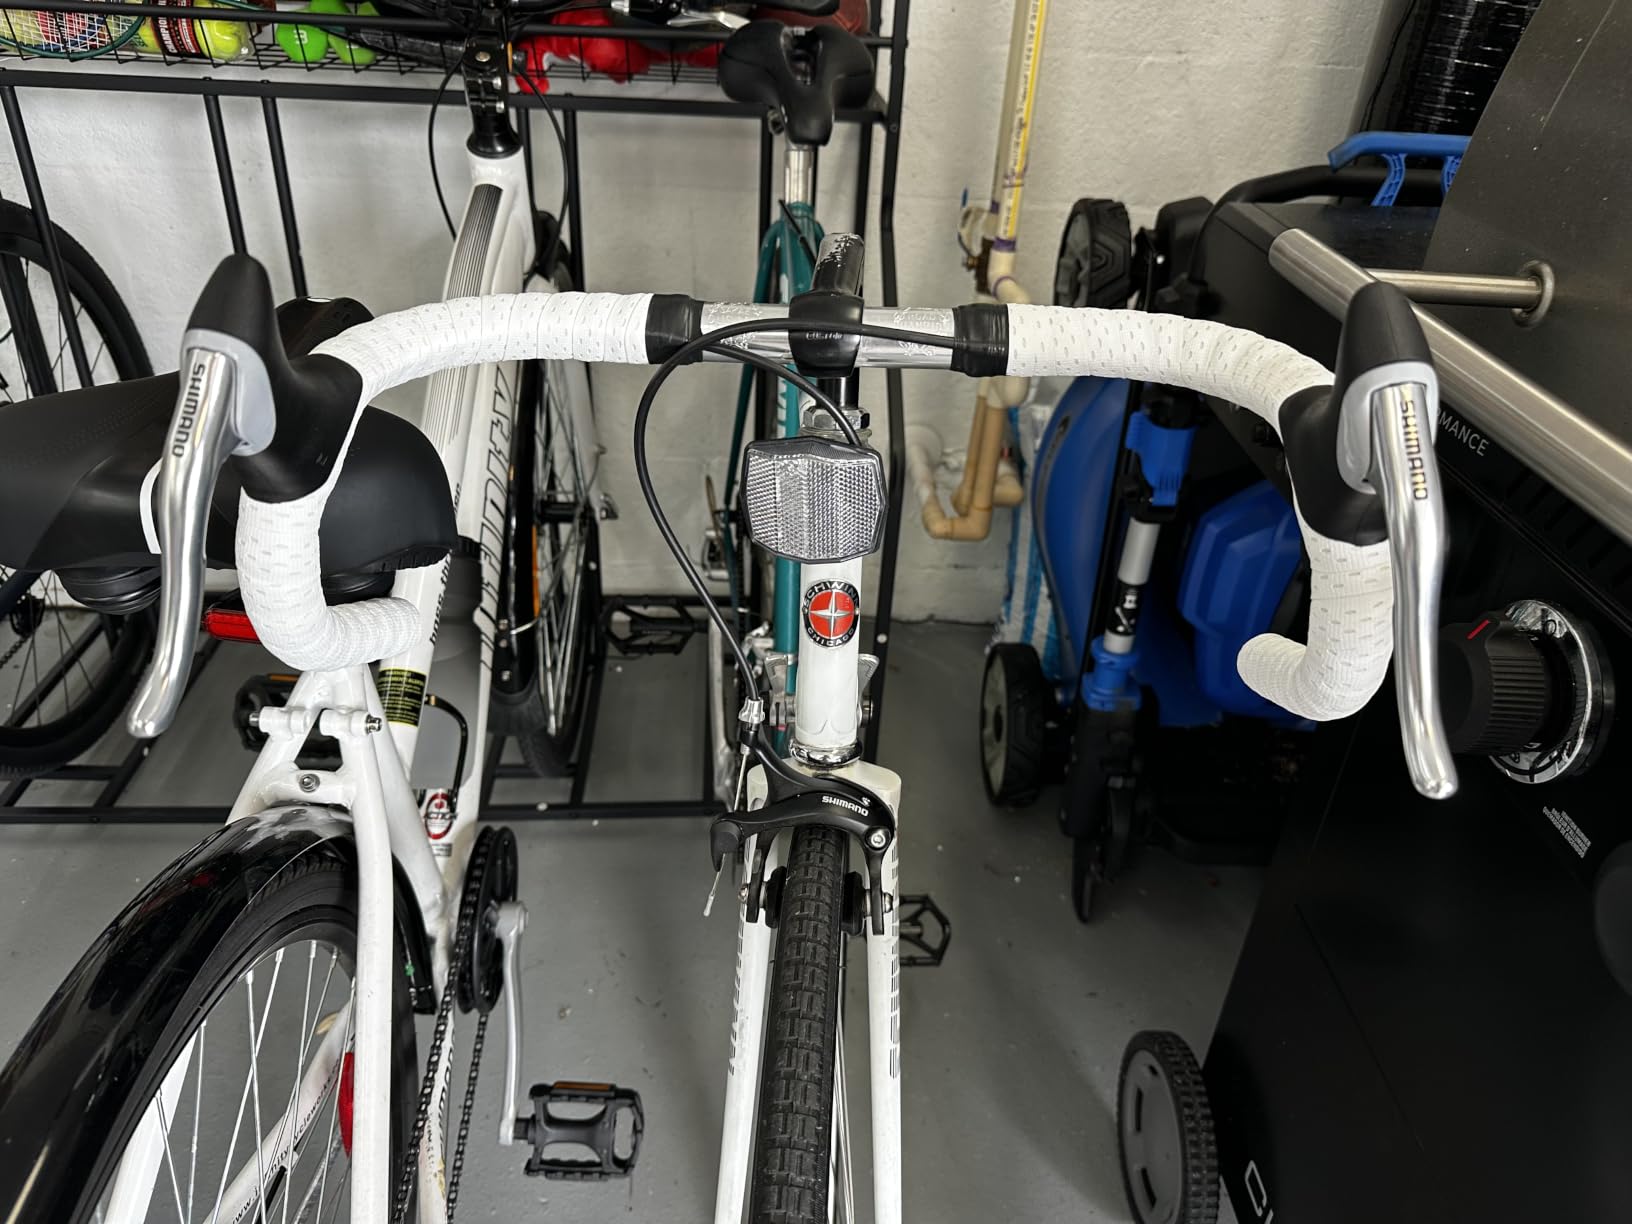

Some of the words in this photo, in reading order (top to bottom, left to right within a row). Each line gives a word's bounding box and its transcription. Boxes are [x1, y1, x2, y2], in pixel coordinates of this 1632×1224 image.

[158, 16, 178, 53] CHAMPIO
[171, 362, 206, 458] SHIMANO
[1400, 400, 1428, 500] SHIMANO
[807, 627, 855, 647] CHICAGO
[821, 795, 869, 817] SHIMANO
